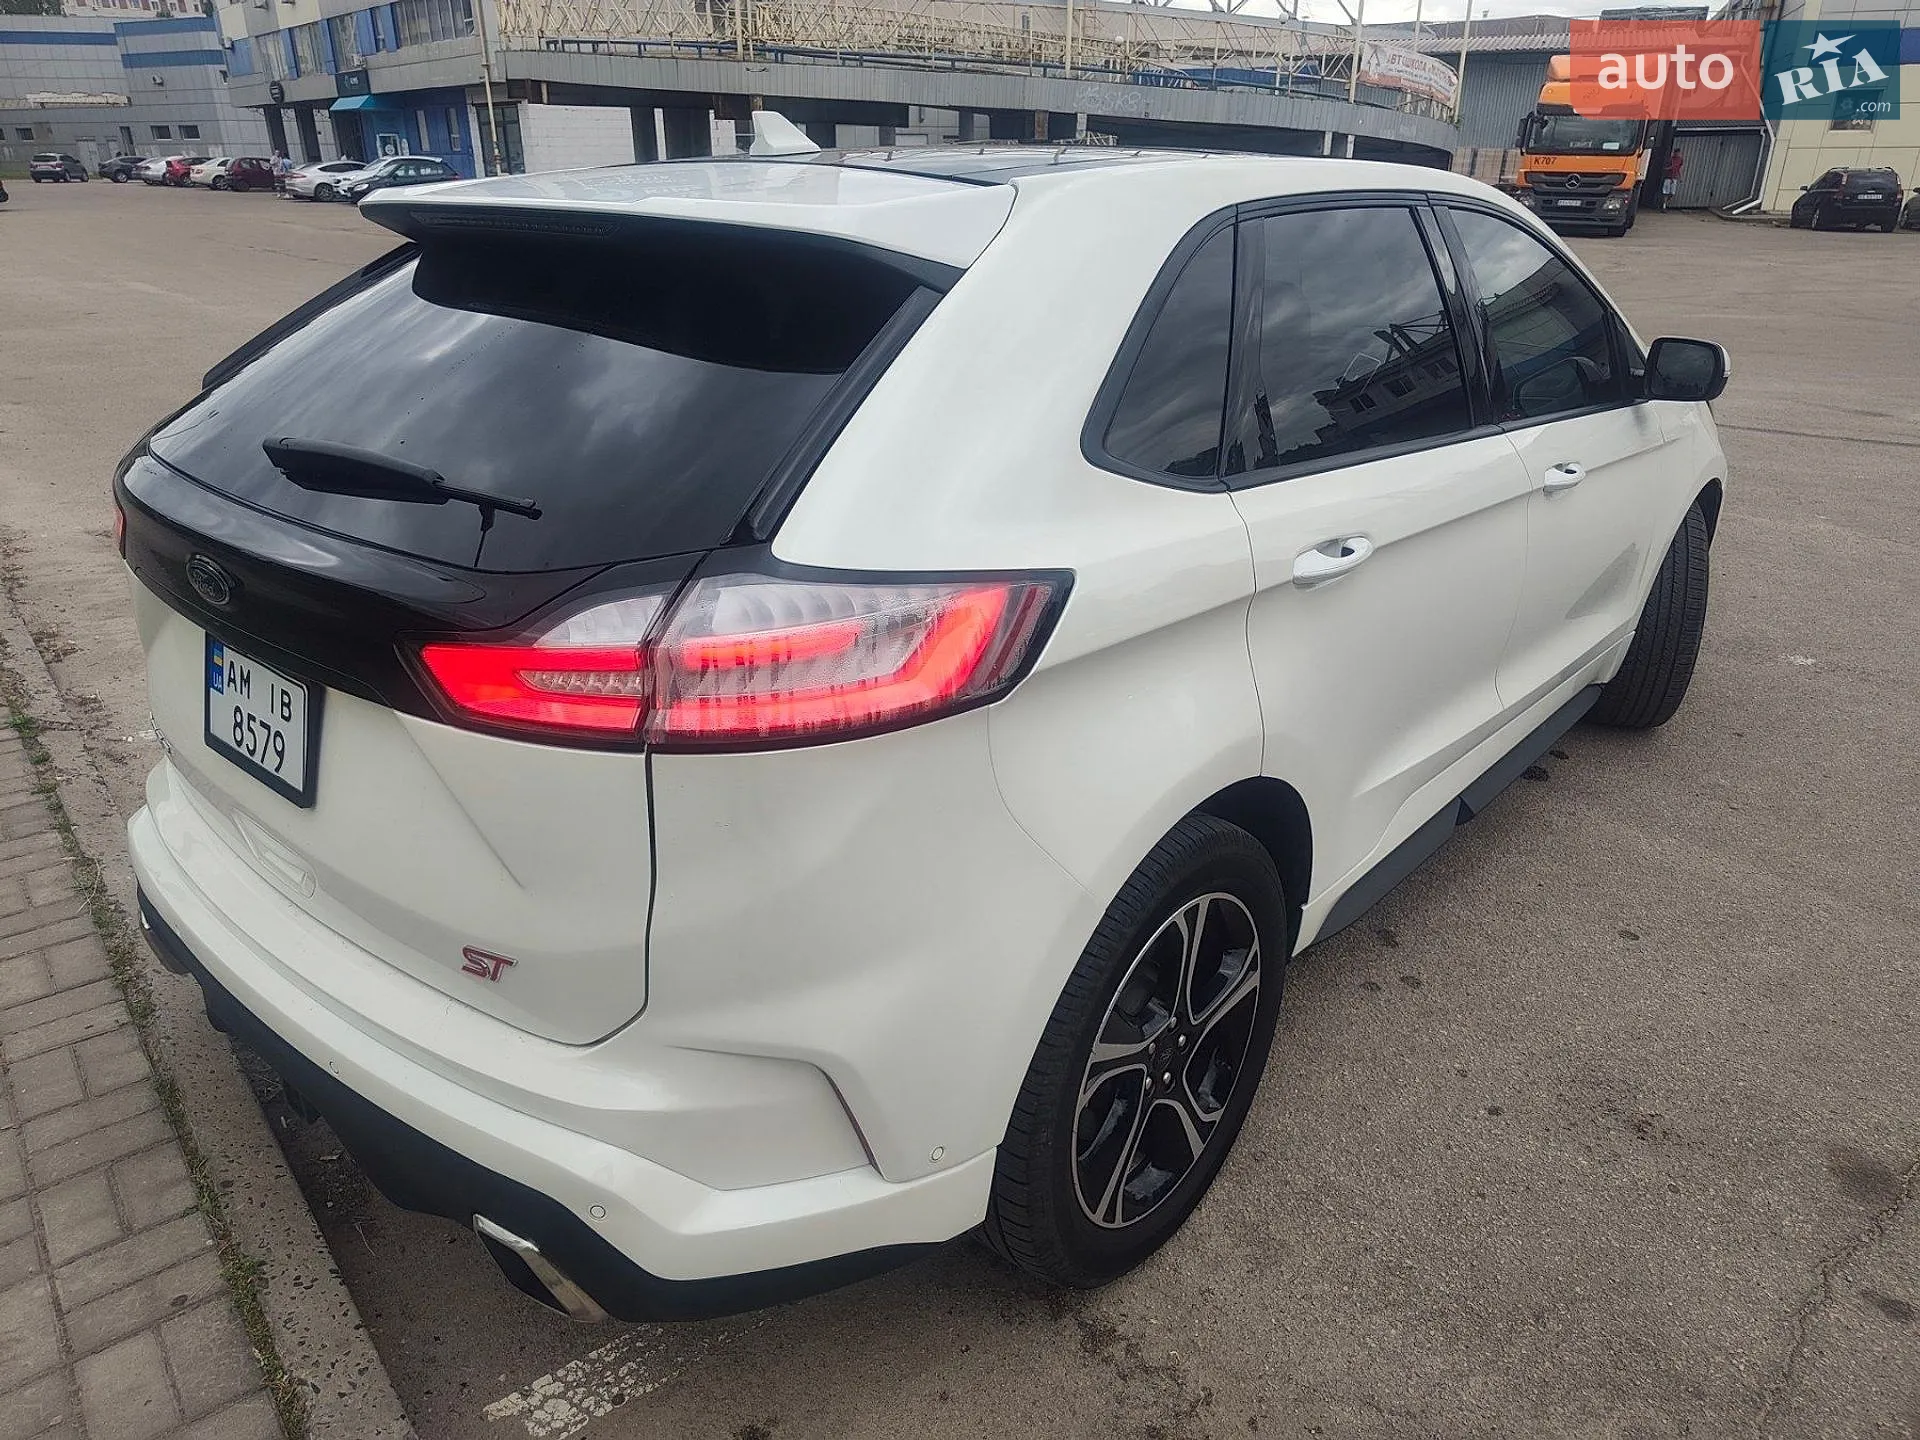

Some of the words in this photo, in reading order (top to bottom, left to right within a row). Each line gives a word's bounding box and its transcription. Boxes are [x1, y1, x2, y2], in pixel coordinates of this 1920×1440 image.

[1533, 157, 1557, 165] K707
[212, 671, 223, 690] UA
[227, 660, 250, 700] AM
[271, 683, 292, 722] IB
[232, 705, 285, 773] 8579
[461, 945, 519, 983] ST
